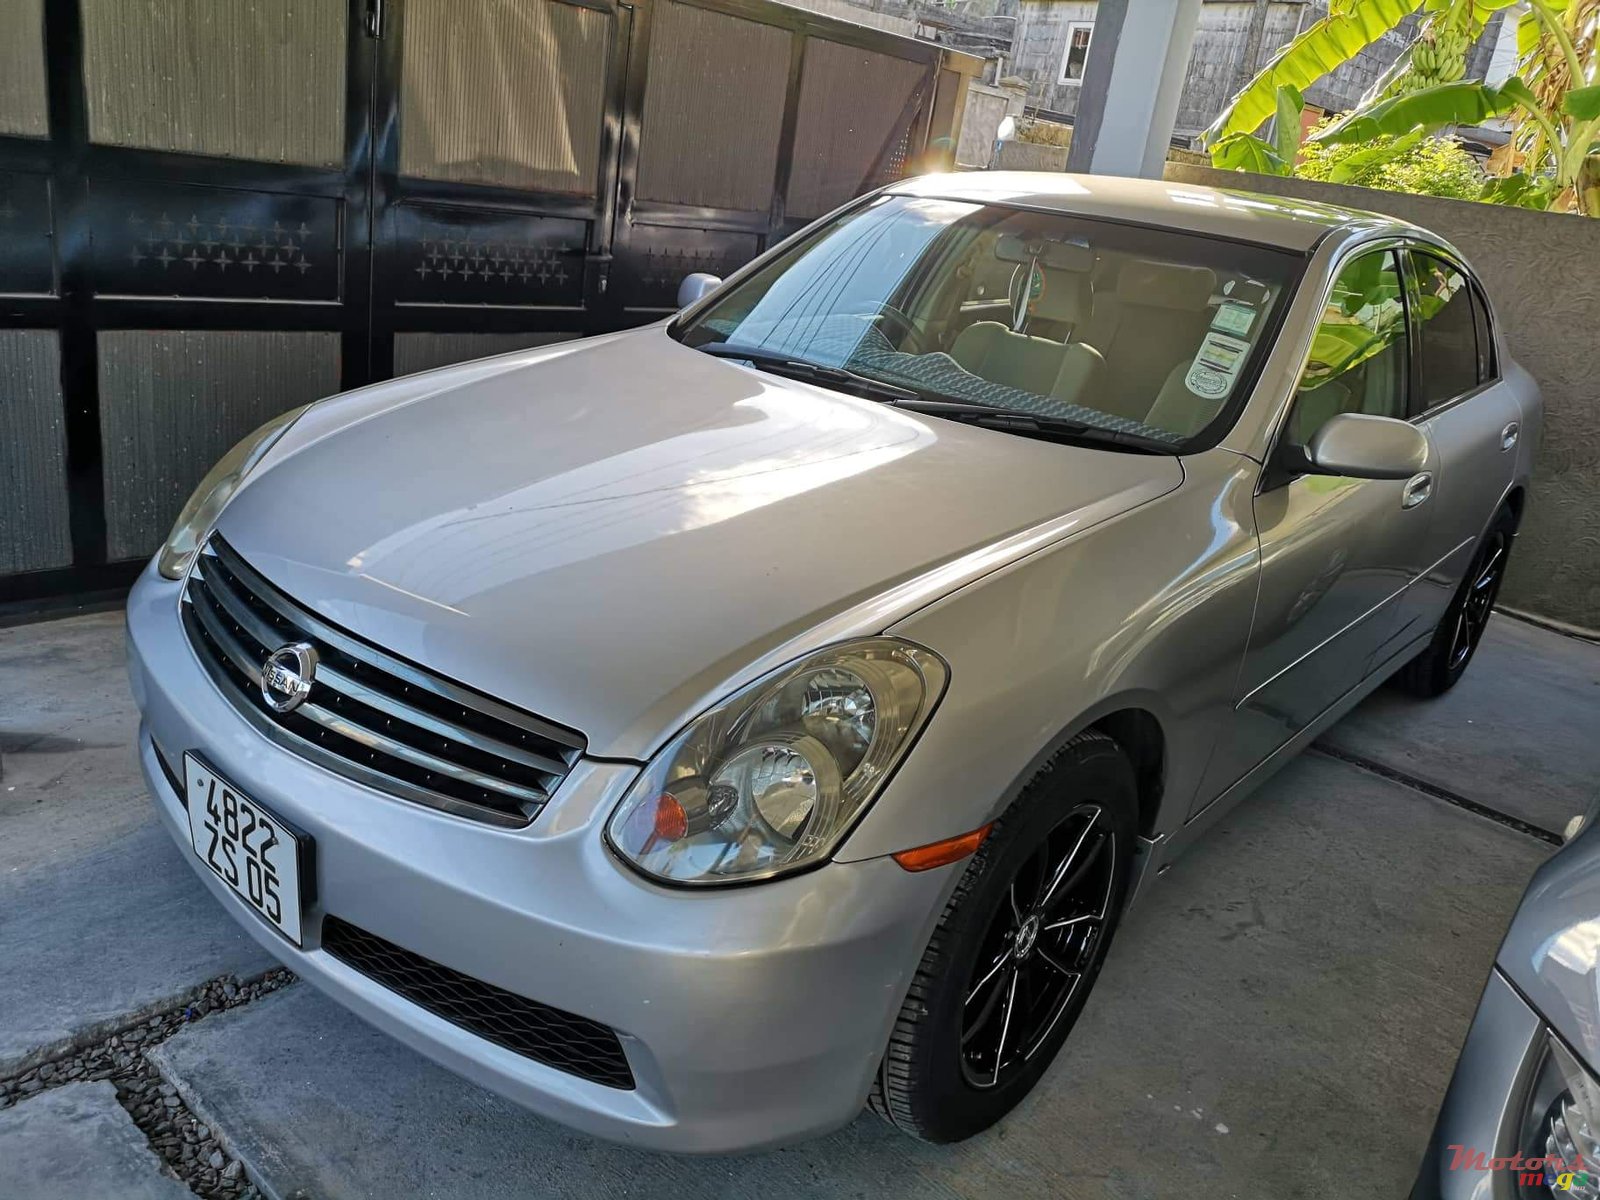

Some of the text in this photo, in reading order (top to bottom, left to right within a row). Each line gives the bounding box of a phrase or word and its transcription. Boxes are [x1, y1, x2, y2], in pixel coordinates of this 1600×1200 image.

[204, 820, 281, 924] ZS 05
[207, 779, 279, 873] 4822
